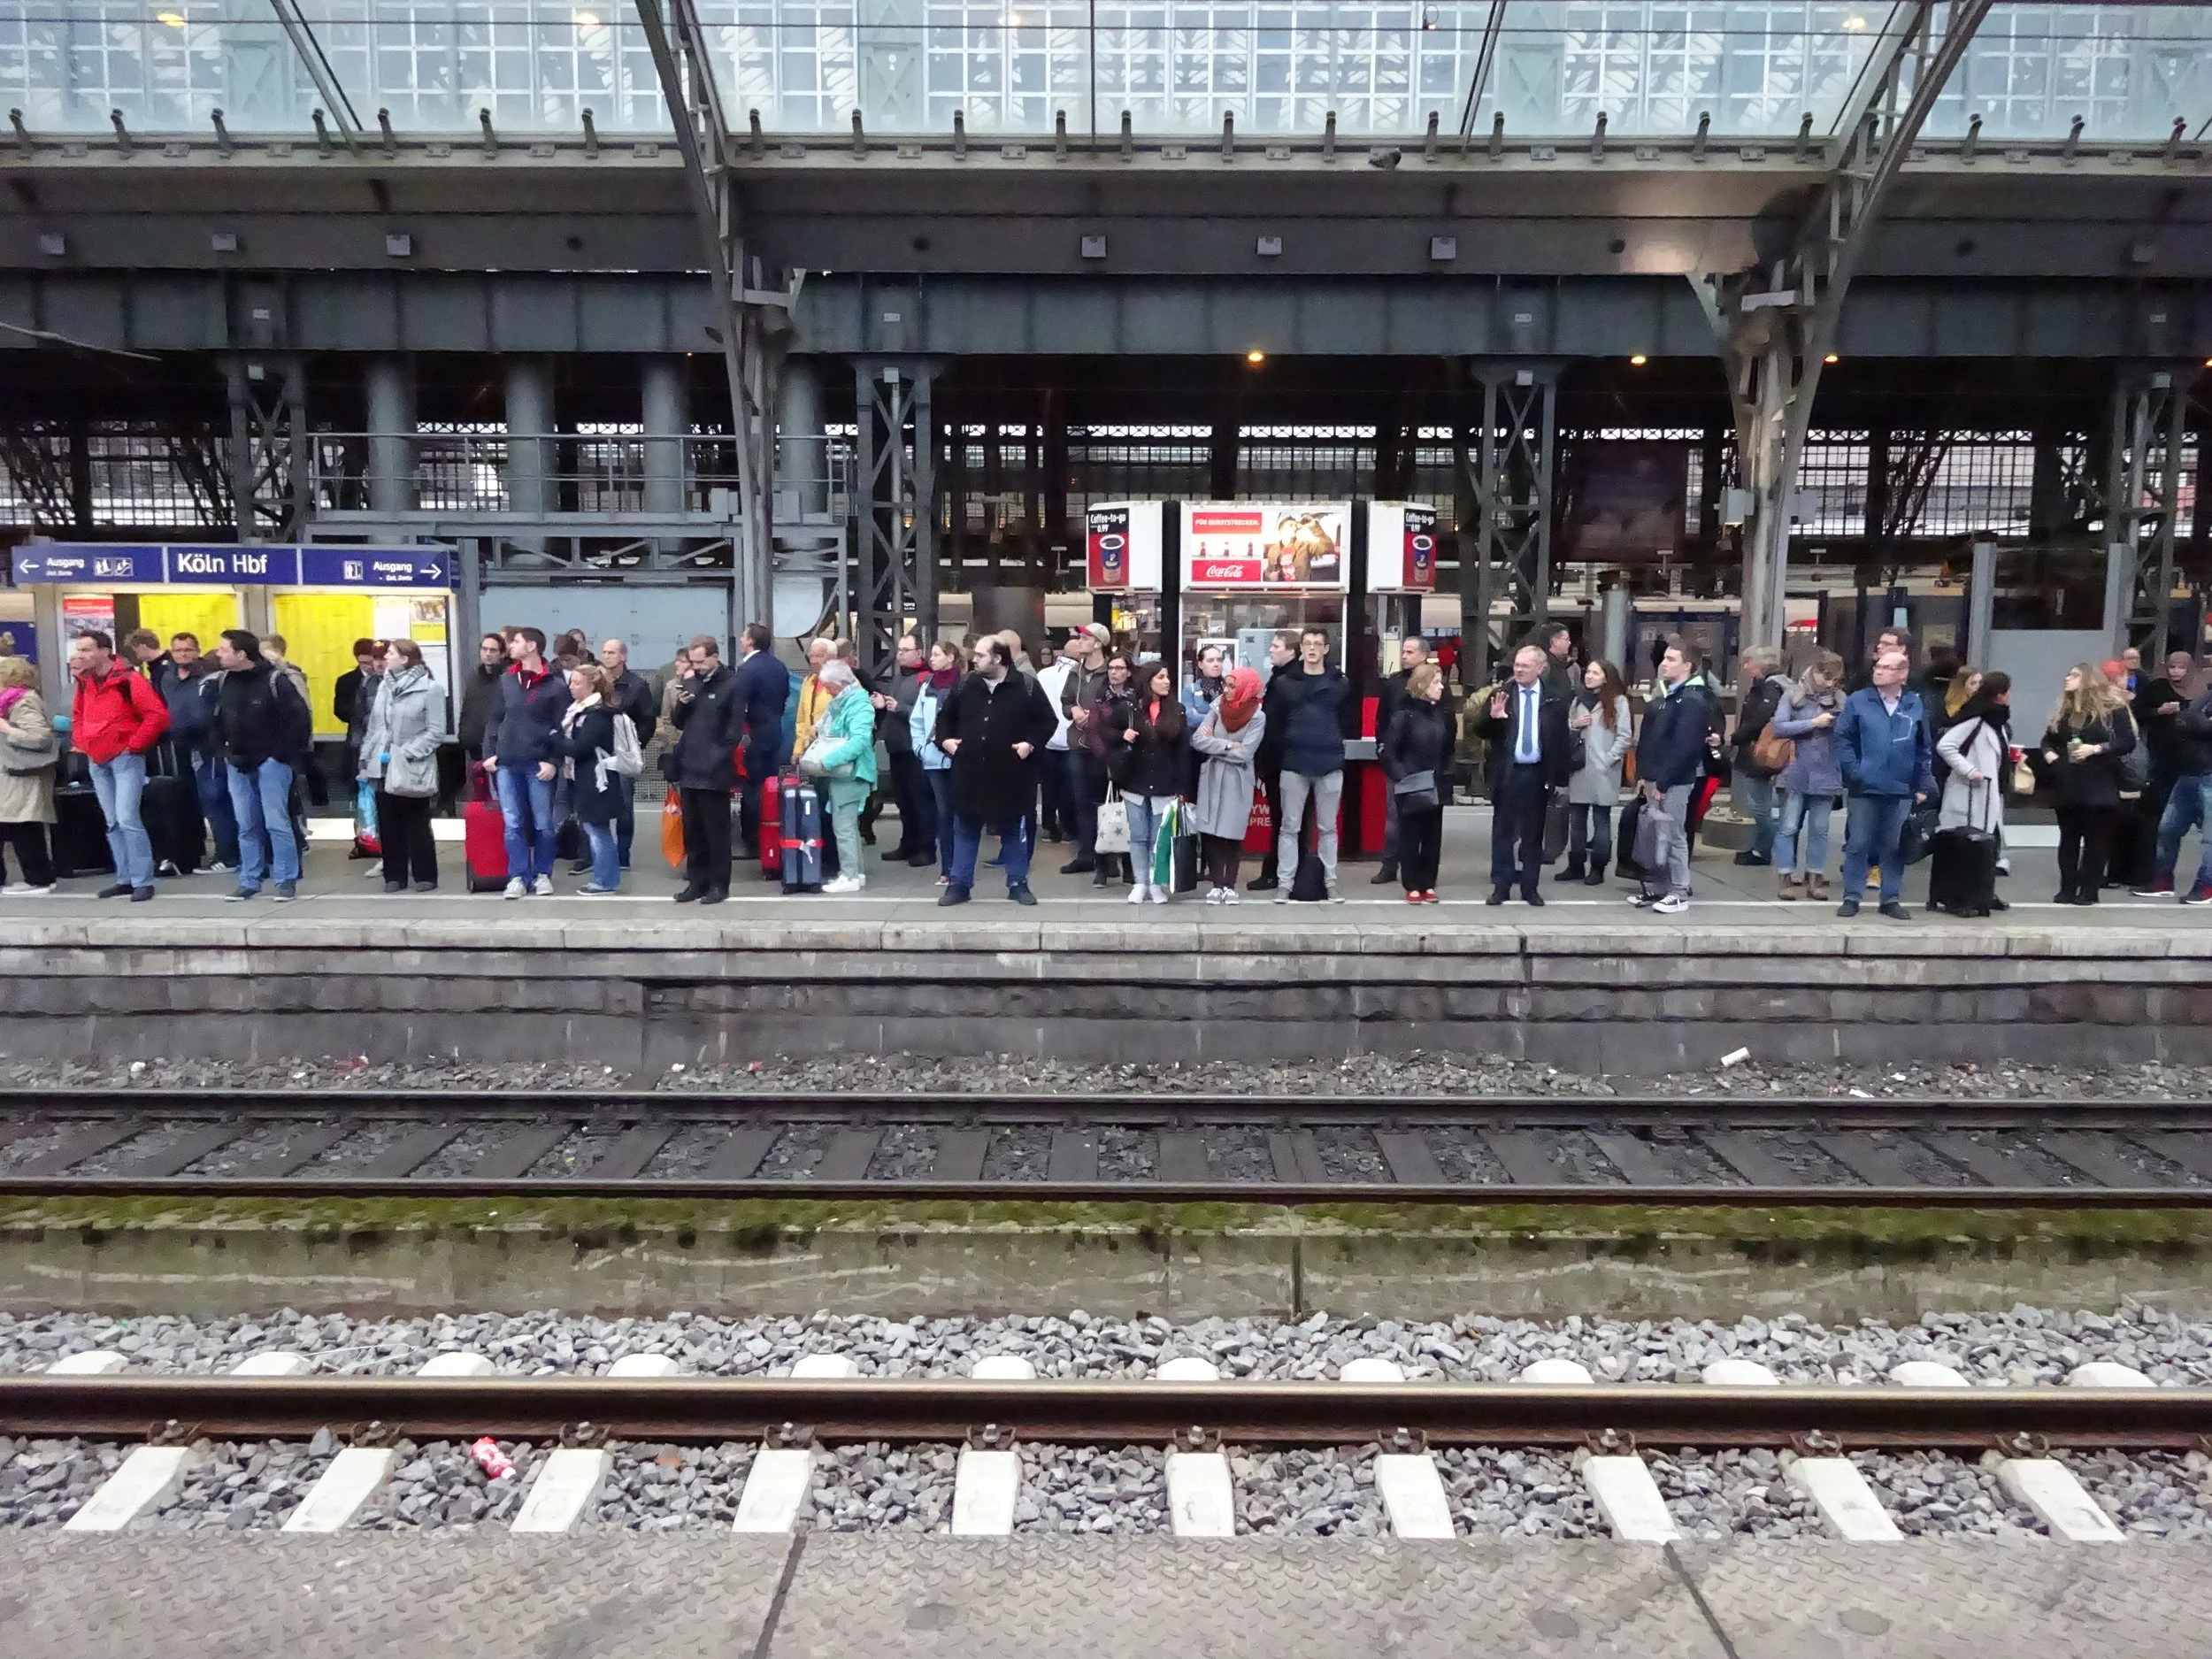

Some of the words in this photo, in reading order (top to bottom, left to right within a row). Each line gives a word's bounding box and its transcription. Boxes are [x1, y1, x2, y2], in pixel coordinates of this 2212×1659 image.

[1090, 513, 1126, 524] Coffee-to-go
[47, 557, 85, 569] Ausgang
[178, 553, 225, 573] Köln
[232, 554, 267, 573] Hbf
[373, 561, 412, 573] Ausgang
